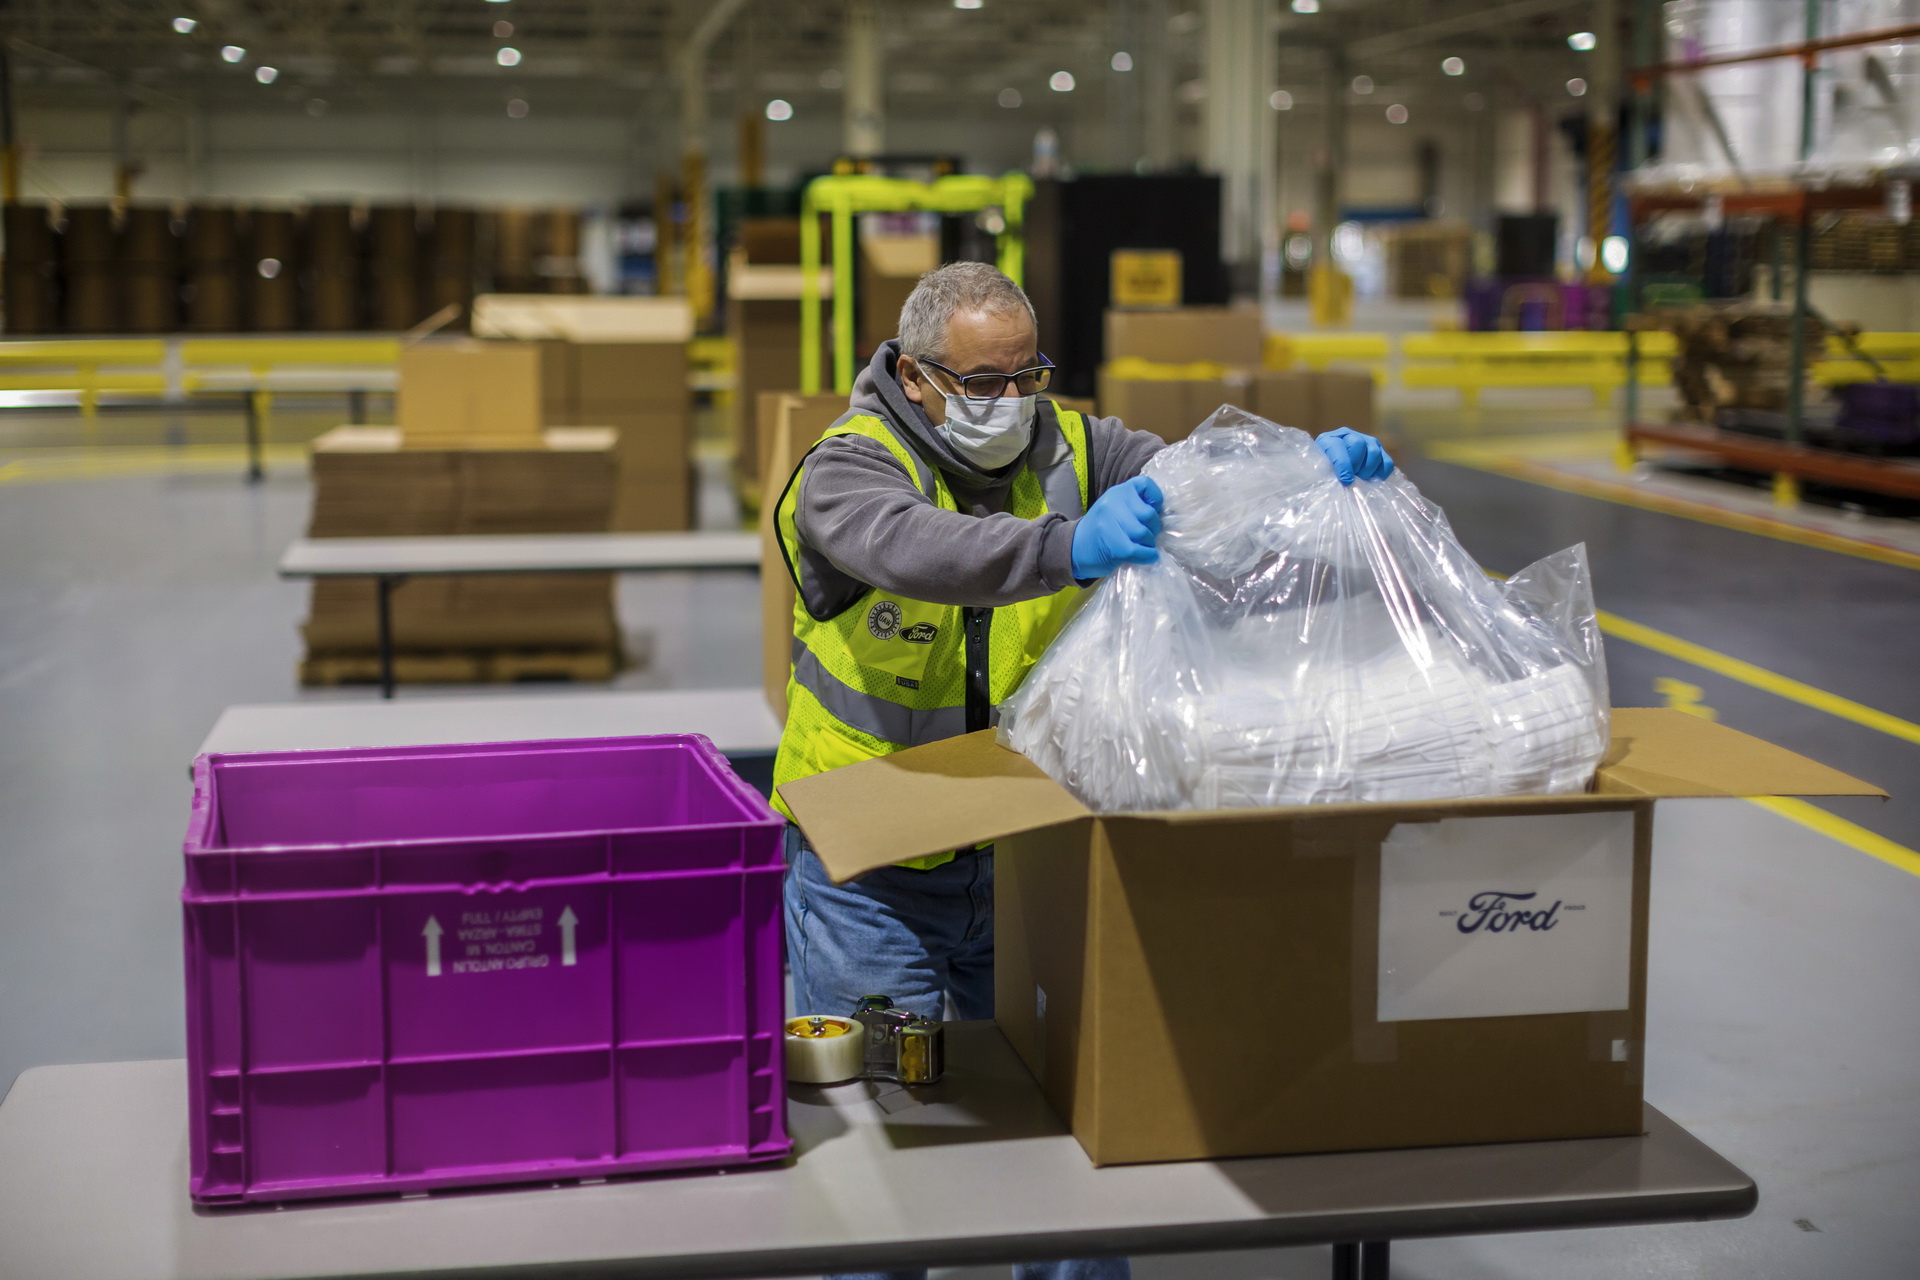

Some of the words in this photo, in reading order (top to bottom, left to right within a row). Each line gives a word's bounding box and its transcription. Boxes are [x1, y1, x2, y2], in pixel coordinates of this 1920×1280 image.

[878, 614, 892, 626] UAW
[908, 625, 935, 641] Ford
[462, 911, 491, 925] FULL
[502, 907, 544, 922] EMPTY
[1457, 891, 1562, 934] Ford
[453, 959, 504, 974] ANTOLIN
[506, 954, 550, 970] GRUPO
